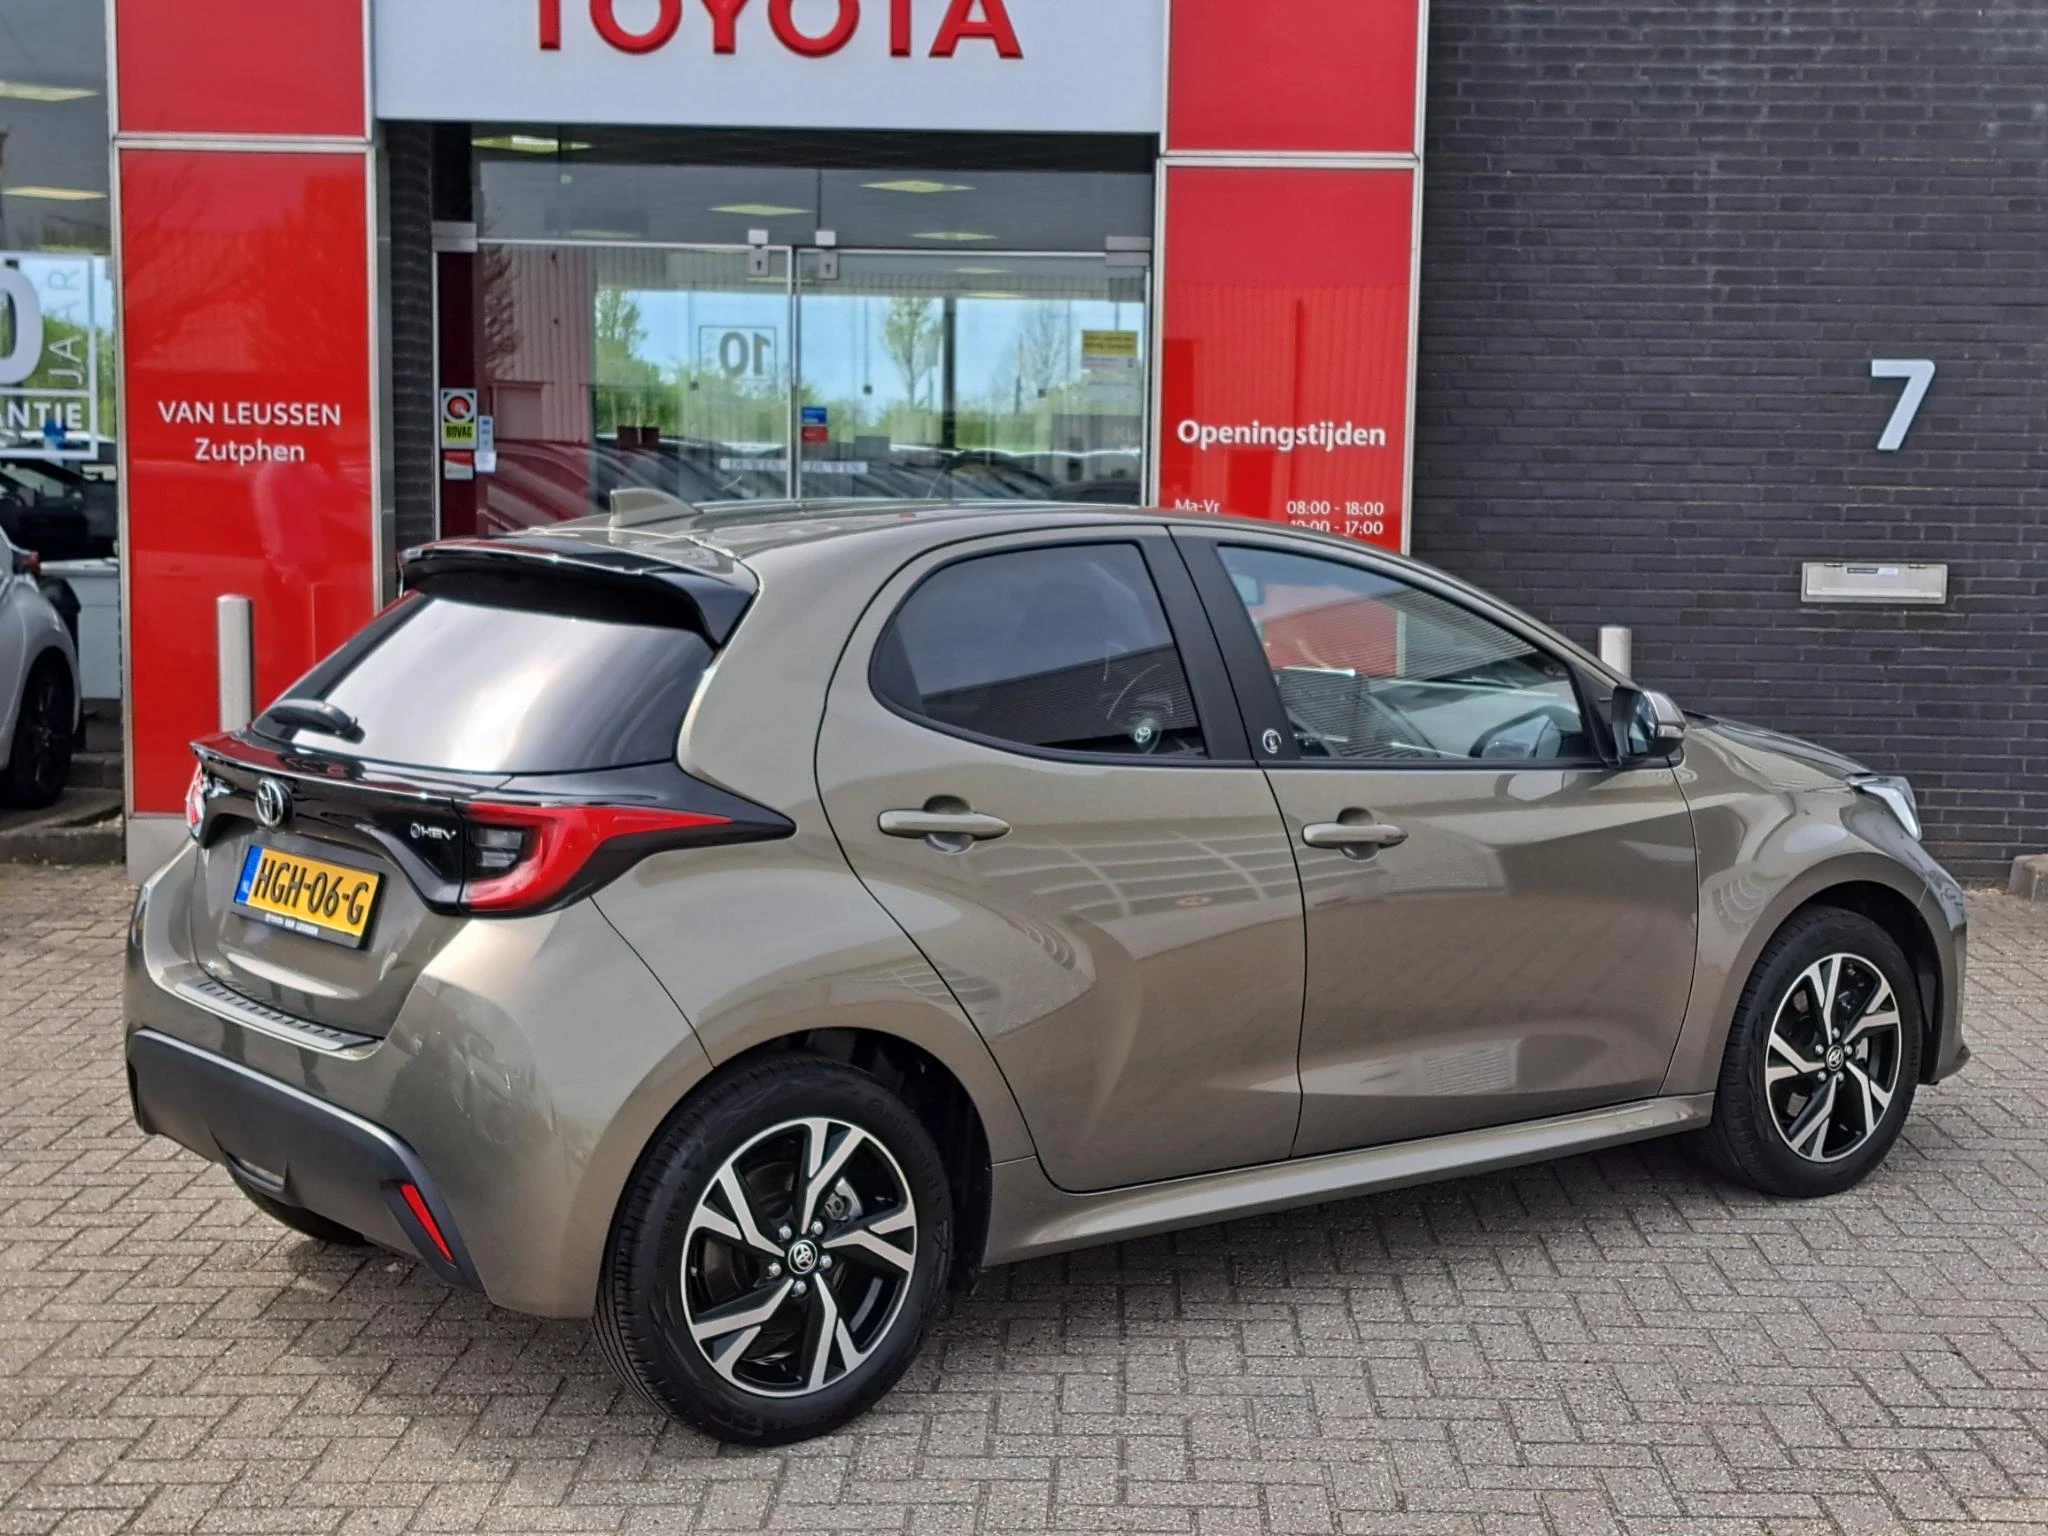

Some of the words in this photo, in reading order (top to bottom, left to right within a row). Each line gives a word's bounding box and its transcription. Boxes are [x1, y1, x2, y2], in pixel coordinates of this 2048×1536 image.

[48, 267, 83, 385] JAAR
[0, 401, 82, 429] NTIE
[157, 400, 214, 424] VAN
[223, 401, 341, 426] LEUSSEN
[1871, 359, 1936, 450] 7
[1177, 419, 1386, 452] Openingstijden
[194, 437, 305, 466] Zutphen
[1174, 498, 1221, 513] Ma-Vr
[1286, 500, 1331, 515] 08:00
[1345, 501, 1384, 516] 18:00
[1345, 521, 1384, 535] 17:00
[253, 858, 370, 926] HGH-06-G
